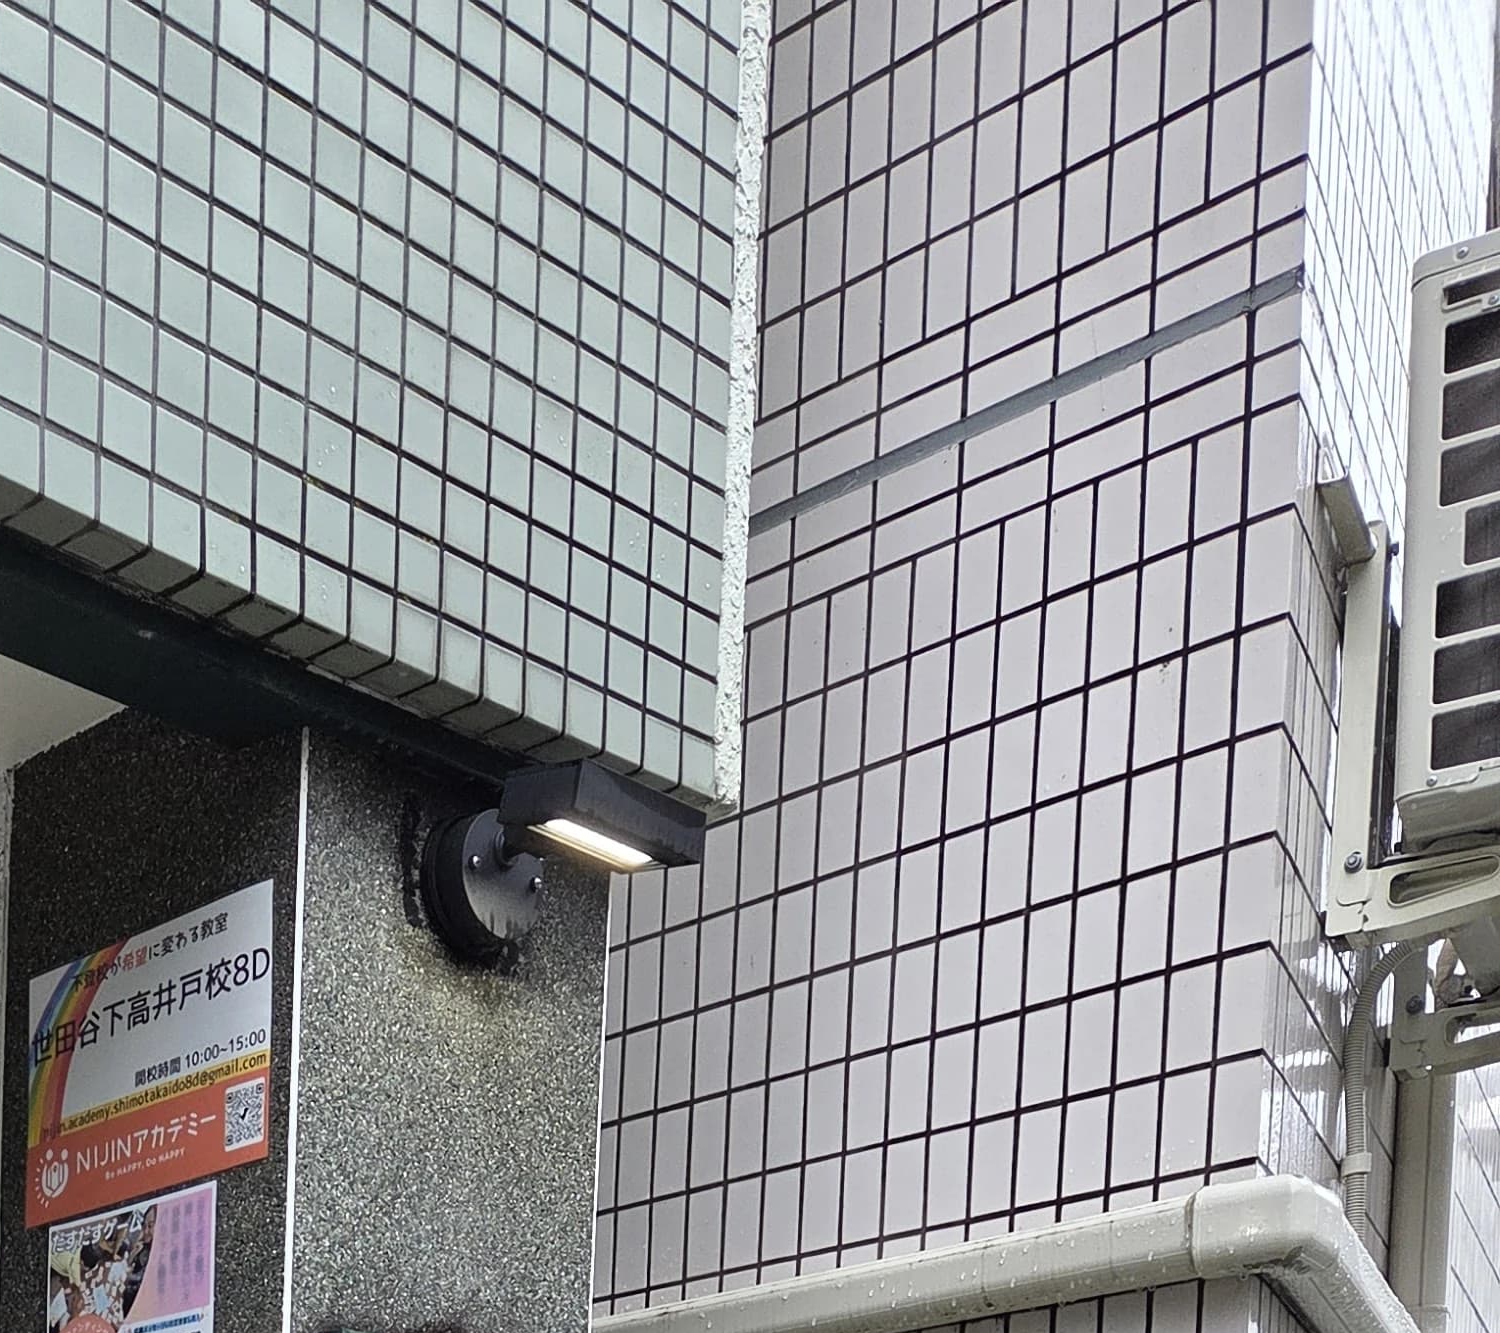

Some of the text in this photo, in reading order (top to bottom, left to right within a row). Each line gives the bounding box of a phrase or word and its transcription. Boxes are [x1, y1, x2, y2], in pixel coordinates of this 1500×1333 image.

[73, 912, 229, 993] 不登校が希望に変わる教室
[32, 947, 270, 1067] 世田谷下高井戸校8D
[76, 1112, 216, 1174] NIJINアカデミー
